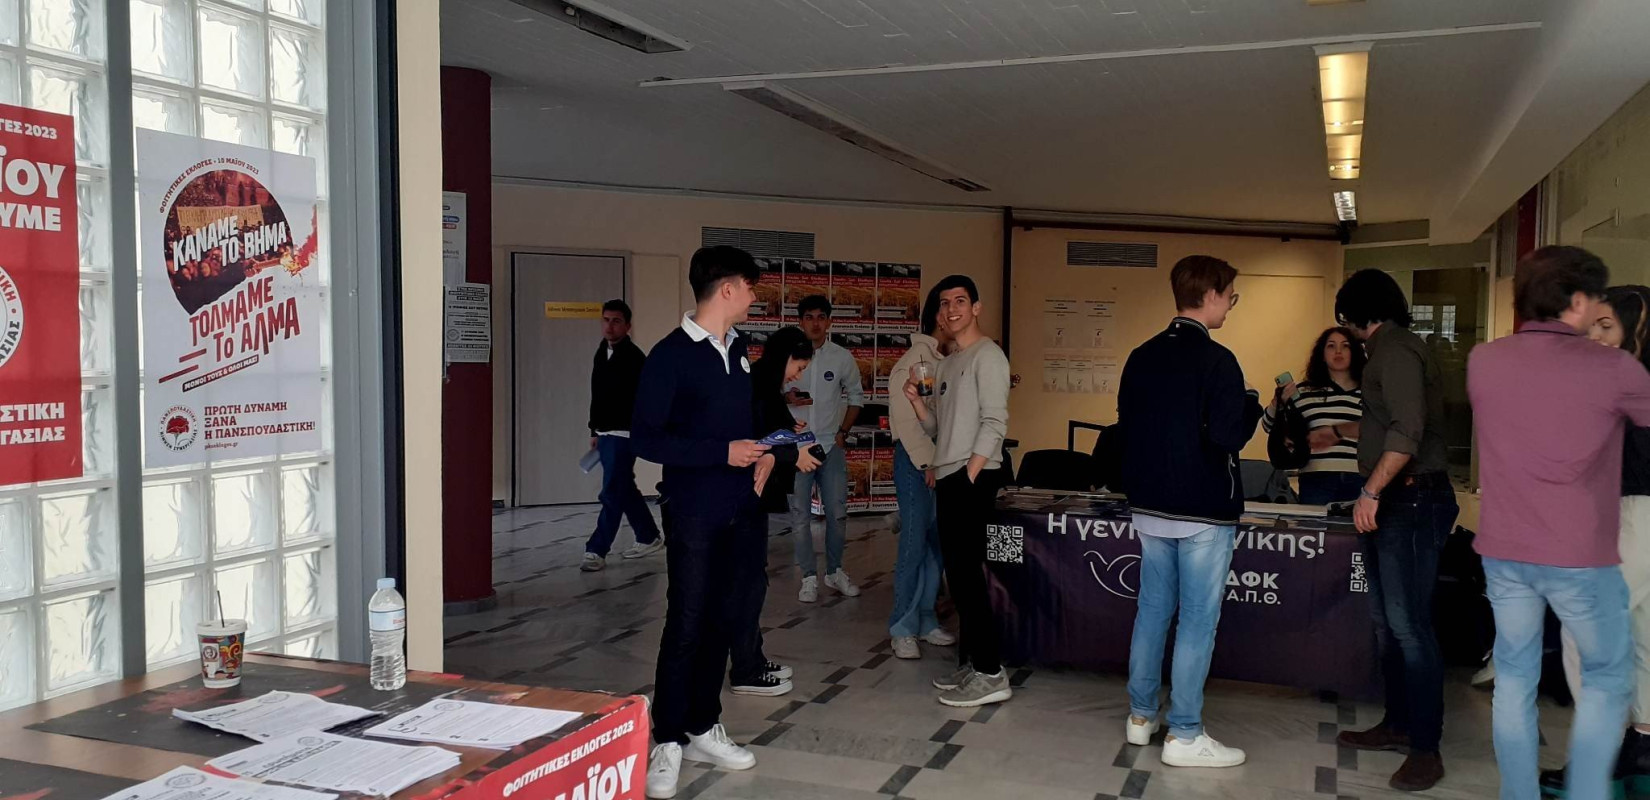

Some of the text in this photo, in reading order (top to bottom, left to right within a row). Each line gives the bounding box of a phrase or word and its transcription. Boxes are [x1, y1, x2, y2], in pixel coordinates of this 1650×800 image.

[24, 123, 58, 140] 2023
[159, 173, 187, 213] ΦΟΙΤΗΤΙΚΕΣ
[185, 158, 213, 176] ΕΚΛΟΓΕΣ
[225, 157, 246, 167] ΜΑΪΟΥ
[246, 163, 259, 175] 2023
[173, 215, 238, 271] ΚΑΝΑΜΕ
[219, 220, 287, 267] ΤΟ ΒΗΜΑ
[189, 276, 273, 346] ΤΟΛΜΑΜΕ
[241, 297, 300, 355] ΑΛΜΑ
[184, 376, 207, 390] ΜΟΝΟΙ
[207, 370, 223, 381] ΤΟΥΣ
[228, 362, 243, 372] ΟΛΟΙ
[0, 402, 65, 423] ΣΤΙΚΗ
[204, 402, 287, 416] ΠΡΩΤΗ ΔΥΝΑΜΗ
[204, 416, 237, 428] ΞΑΝΑ
[204, 421, 316, 440] Η ΠΑΝΣΠΟΥΔΑΣΤΙΚΗ!
[0, 426, 65, 445] ΓΑΣΙΑΣ
[1047, 512, 1326, 559] Η γενι νίκης!
[1225, 569, 1280, 590] ΔΦΚ
[1226, 588, 1281, 605] Α.Π.Θ.
[502, 720, 634, 797] ΦΟΙΤΗΤΙΚΕΣ ΕΚΛΟΓΕΣ 2023
